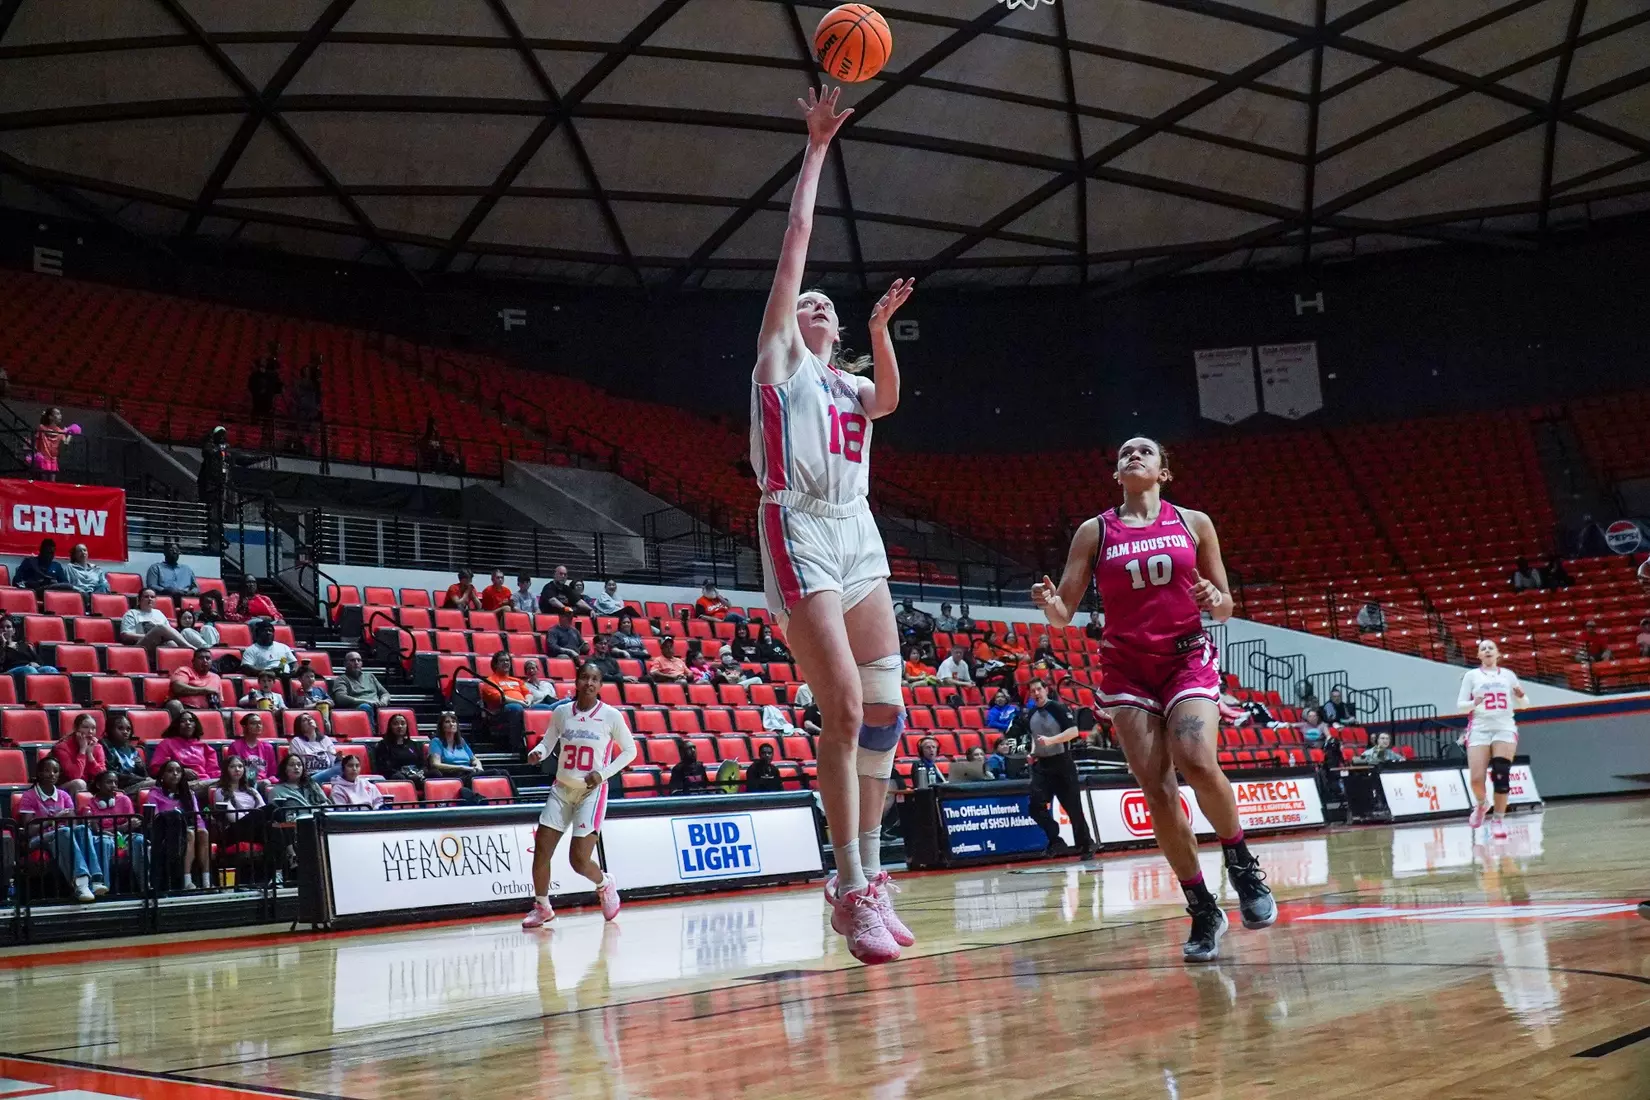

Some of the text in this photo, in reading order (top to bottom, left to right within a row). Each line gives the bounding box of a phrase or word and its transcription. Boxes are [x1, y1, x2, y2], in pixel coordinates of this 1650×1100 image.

[33, 244, 64, 276] E
[1294, 291, 1325, 316] H
[503, 308, 527, 331] F
[894, 320, 920, 341] G
[828, 404, 867, 464] 18
[13, 504, 108, 537] CREW
[1106, 534, 1188, 560] SAM HOUSTON
[1125, 554, 1173, 590] 10
[1484, 692, 1508, 710] 25
[563, 744, 595, 771] 30
[1237, 781, 1300, 802] ARTECH
[943, 803, 1020, 819] The Official Internet
[688, 822, 740, 846] BUD
[947, 821, 979, 835] provider
[980, 820, 989, 830] of
[988, 817, 1009, 829] SHSU
[382, 833, 510, 862] MEMORIAL
[681, 844, 752, 872] LIGHT
[384, 852, 511, 882] HERMANN
[492, 880, 560, 896] Orthopcs
